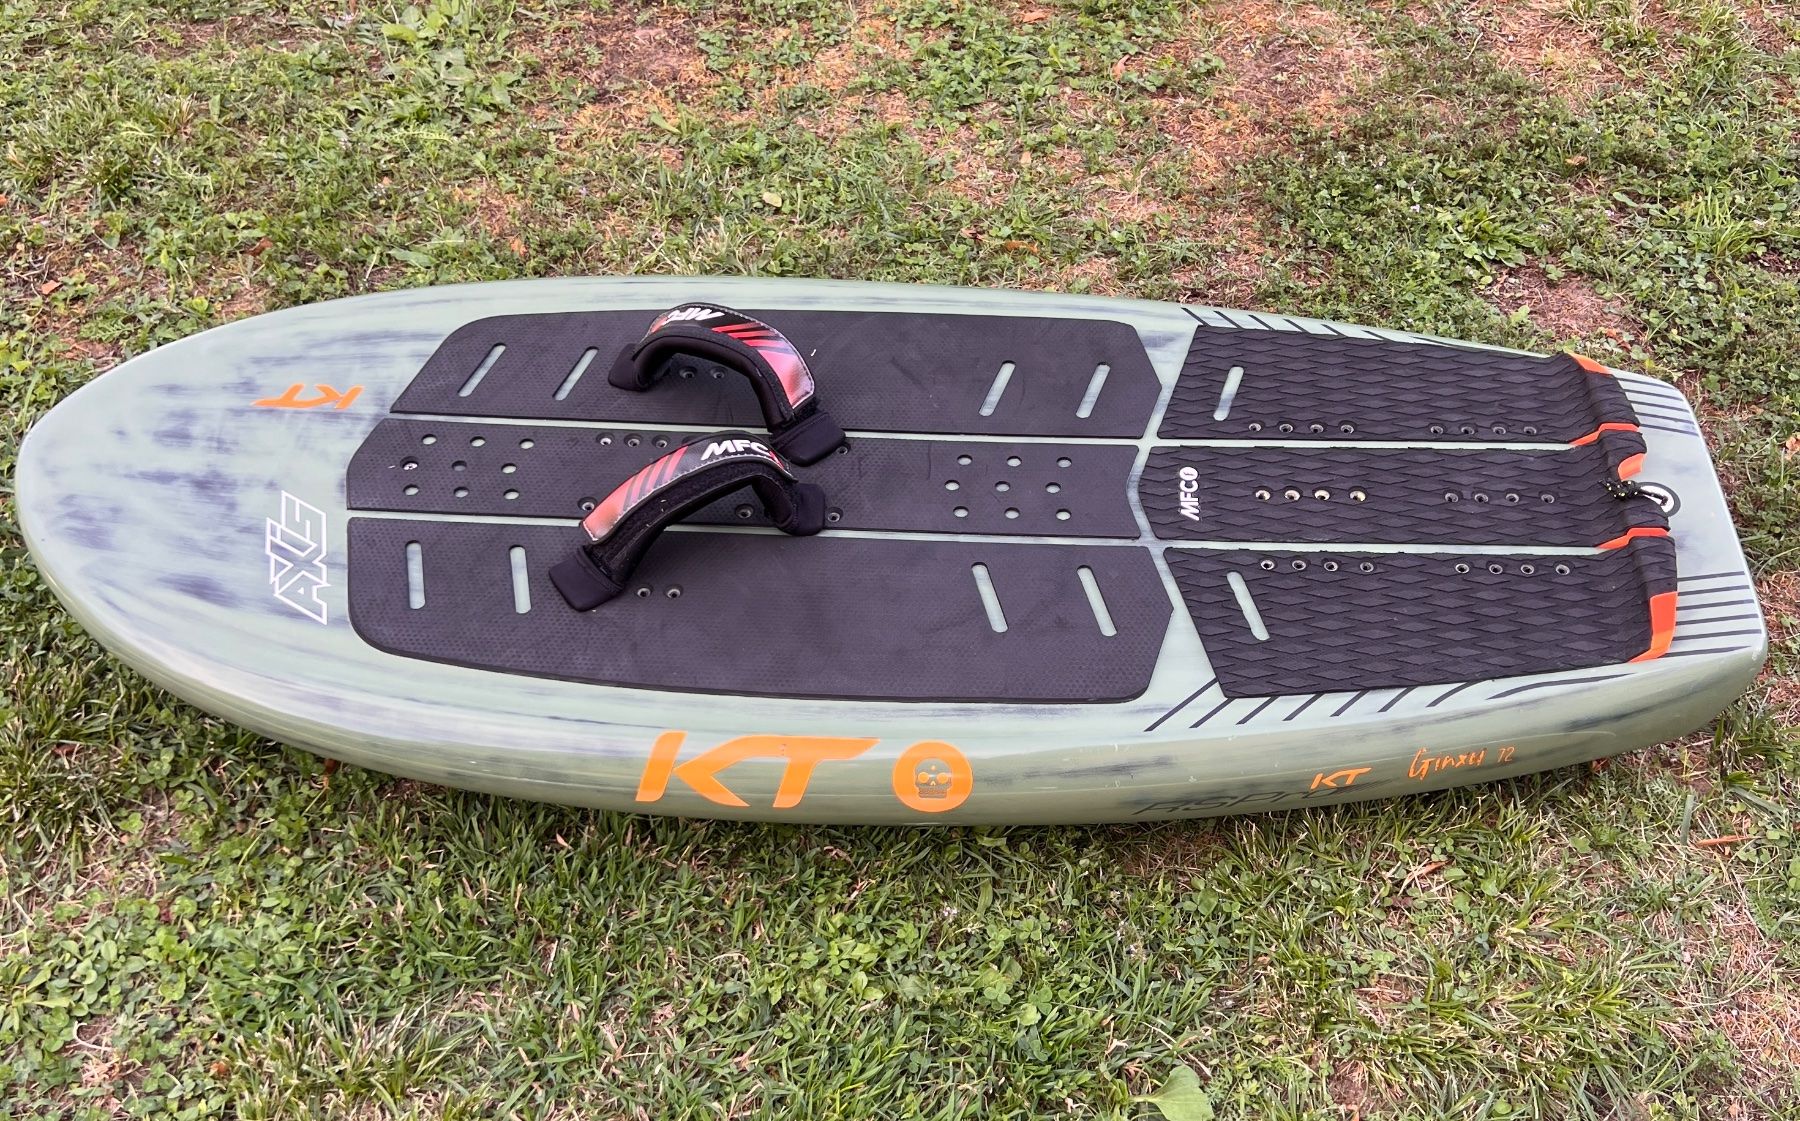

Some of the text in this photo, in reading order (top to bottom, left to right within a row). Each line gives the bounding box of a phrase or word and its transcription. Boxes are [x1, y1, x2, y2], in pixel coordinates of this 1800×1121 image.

[250, 384, 363, 409] KT
[265, 490, 331, 625] AXIS
[635, 730, 880, 808] KT
[1310, 767, 1372, 790] KT
